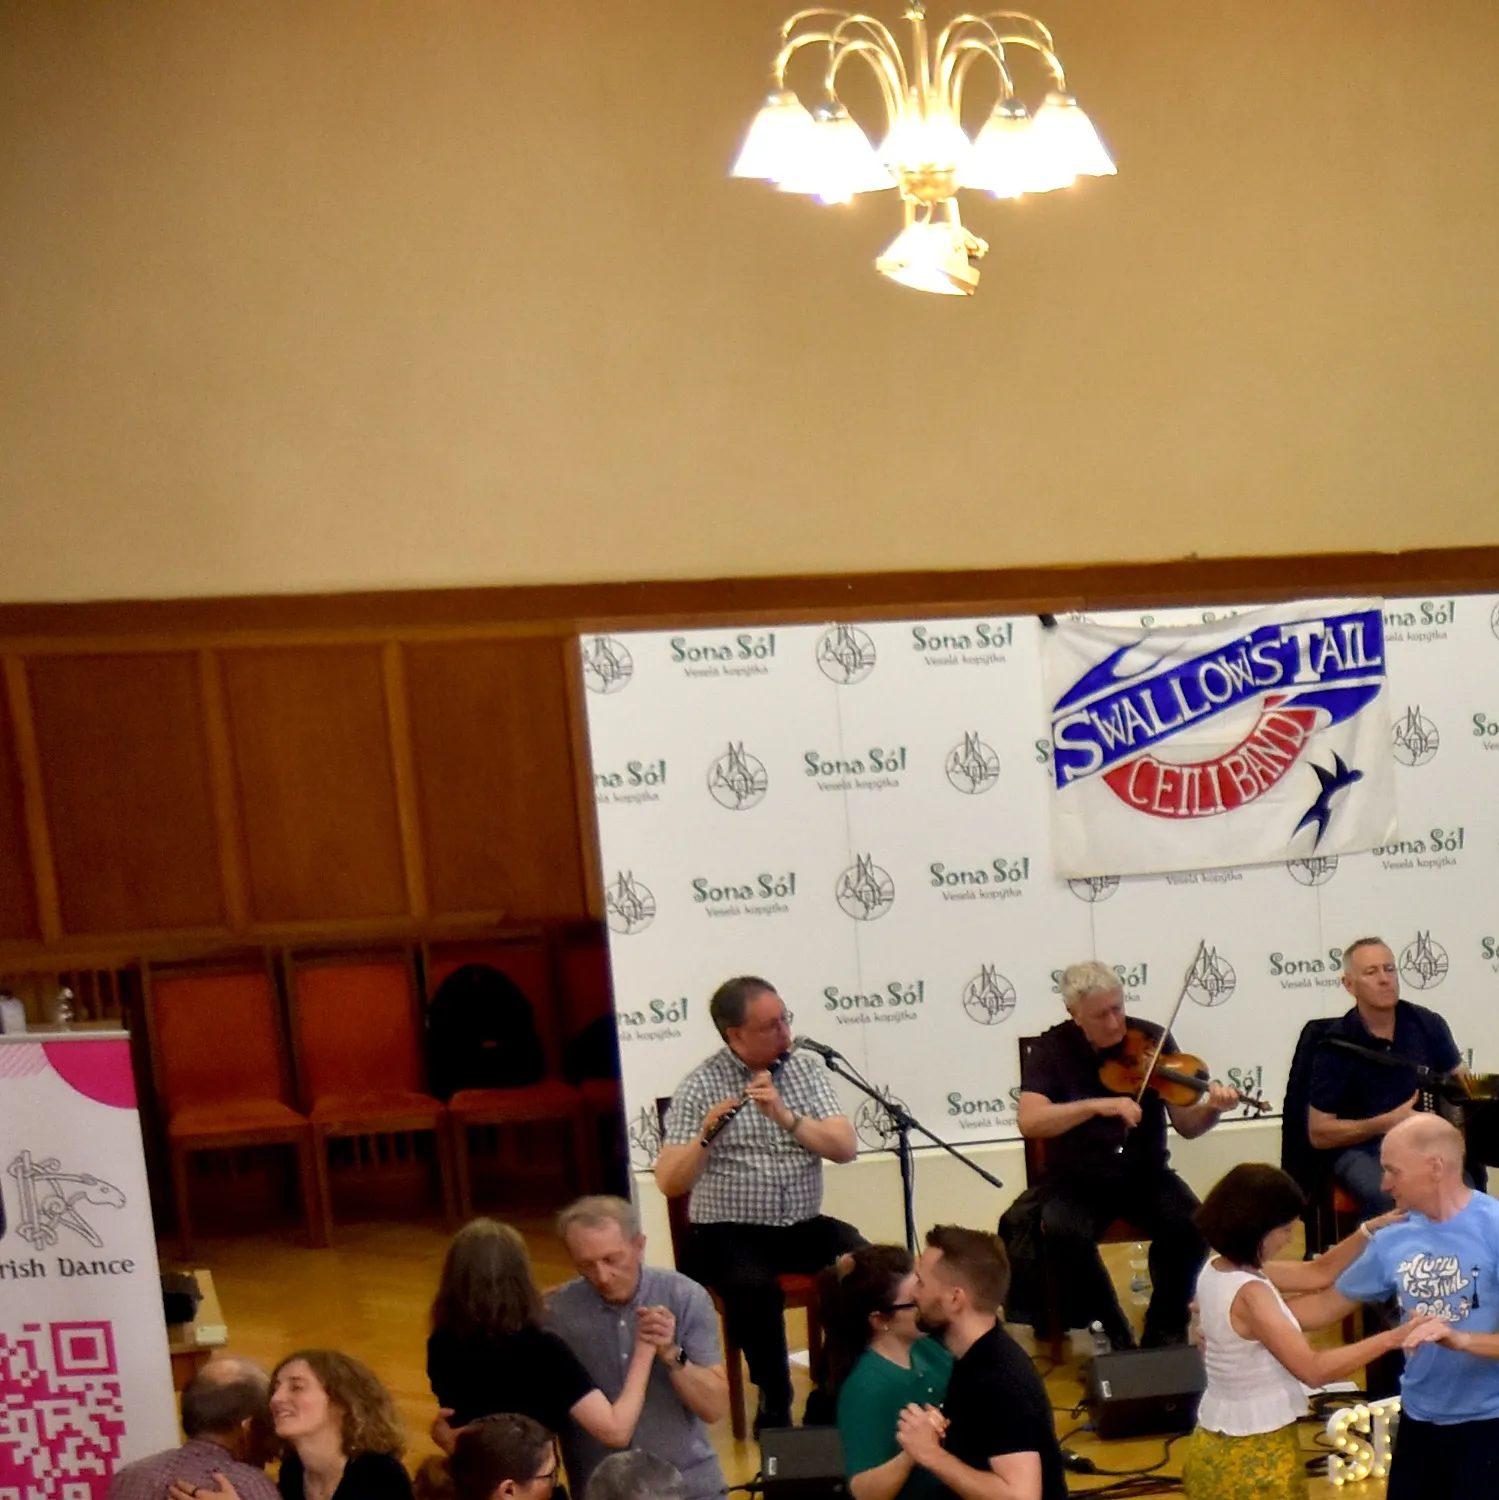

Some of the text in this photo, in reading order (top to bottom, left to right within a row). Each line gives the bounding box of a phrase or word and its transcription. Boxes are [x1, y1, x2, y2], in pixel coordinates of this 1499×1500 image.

[1420, 601, 1456, 625] Sól
[670, 633, 776, 664] Sona Sól
[912, 622, 1014, 652] Sona Sól
[1280, 619, 1382, 683] TAIL
[804, 747, 907, 777] Sona Sól
[1129, 753, 1228, 817] CEILI
[1227, 710, 1311, 805] BAND
[1431, 827, 1465, 851] Sól
[929, 857, 1030, 888] Sona Sól
[692, 872, 797, 904] Sona Sól
[1269, 952, 1326, 976] Sona
[823, 980, 925, 1011] Sona Sól
[946, 1091, 1006, 1117] Sona
[0, 1257, 135, 1279] rish Dance
